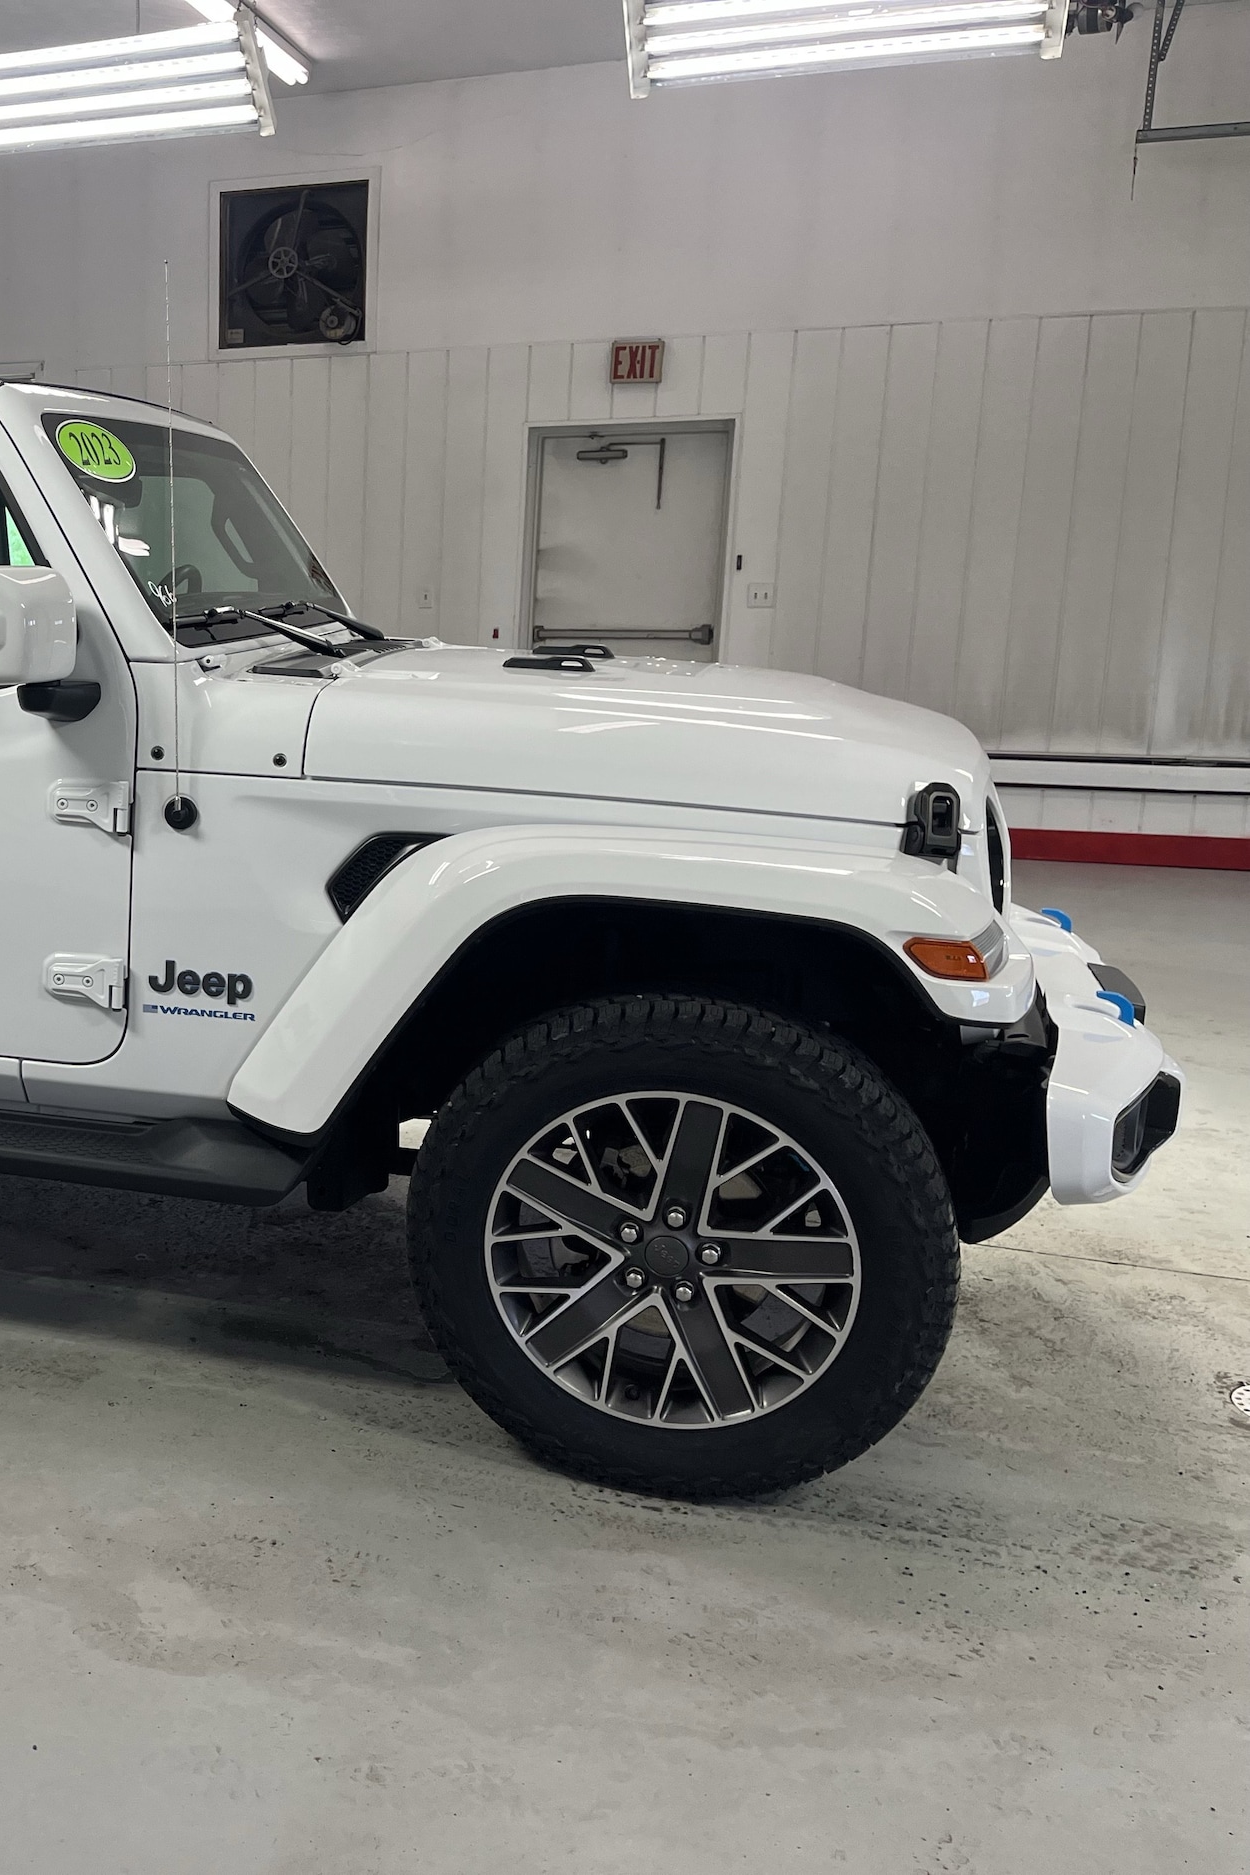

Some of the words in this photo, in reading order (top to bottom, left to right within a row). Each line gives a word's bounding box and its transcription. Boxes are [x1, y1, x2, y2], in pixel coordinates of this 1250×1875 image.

[613, 345, 660, 380] EXIT
[69, 432, 121, 466] 2023
[148, 960, 253, 1006] Jeep
[159, 1005, 256, 1021] WRANGLER
